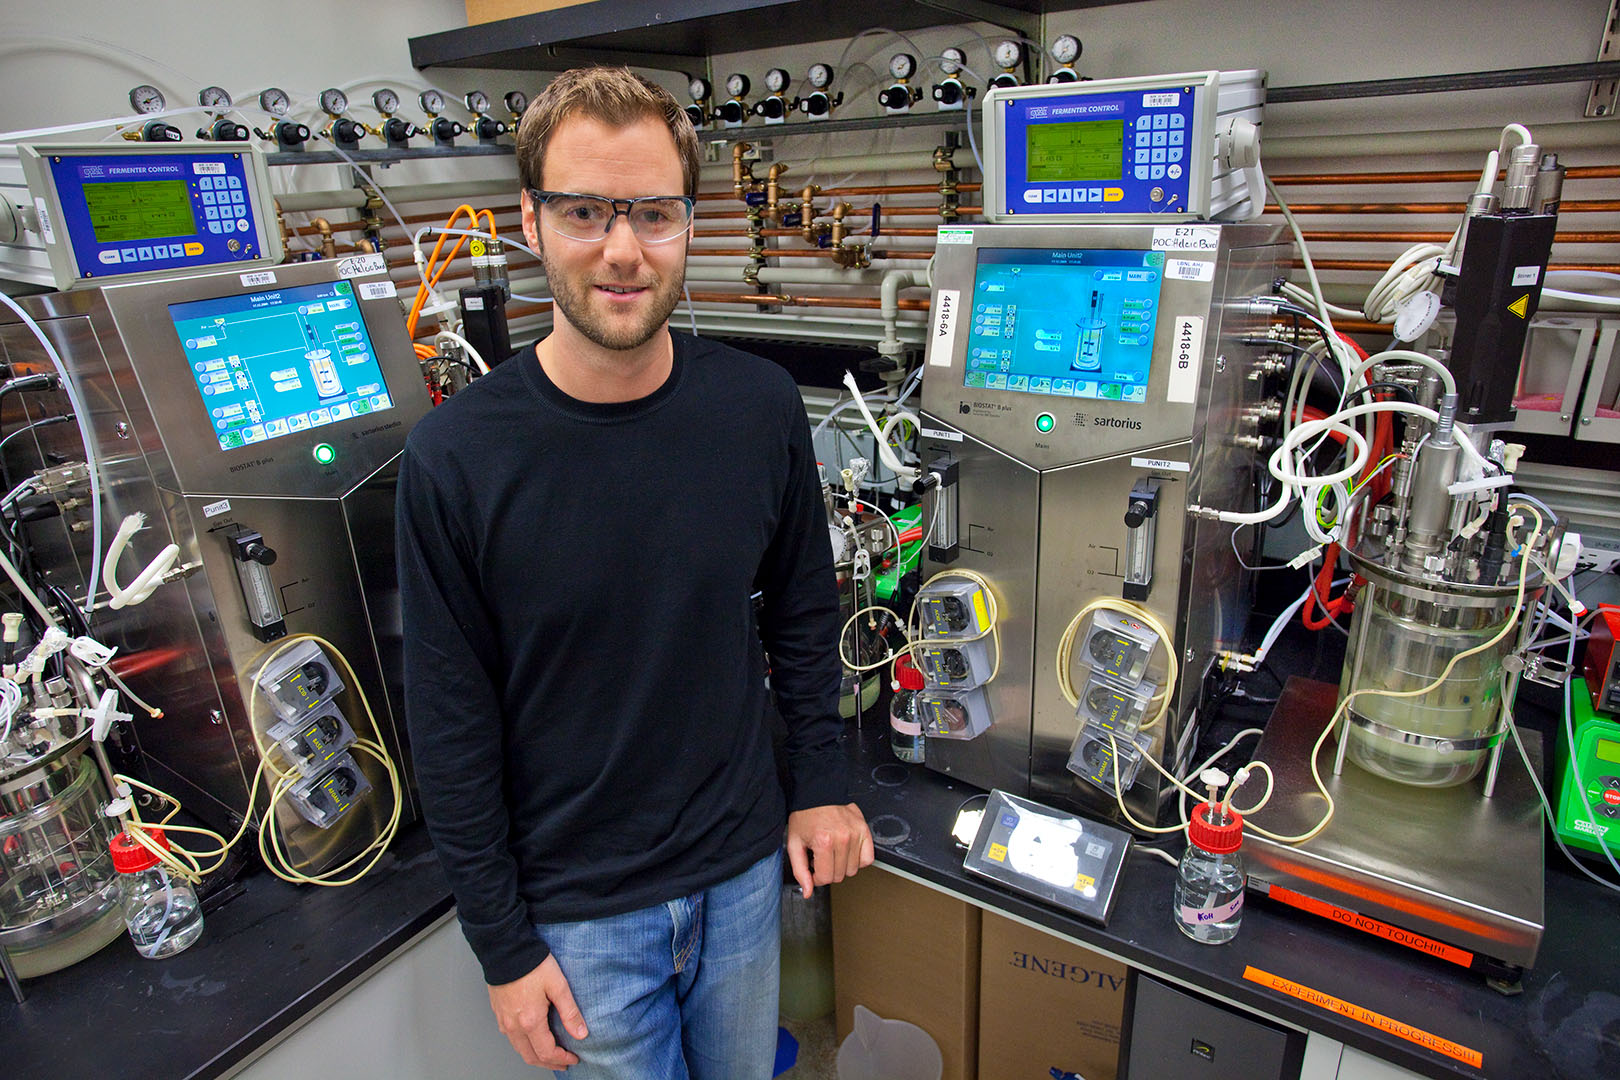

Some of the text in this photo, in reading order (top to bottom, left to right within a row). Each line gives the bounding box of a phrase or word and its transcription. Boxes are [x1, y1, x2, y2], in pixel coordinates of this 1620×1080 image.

[1052, 106, 1087, 115] FERMENTER
[1088, 104, 1120, 112] CONTROL
[1176, 228, 1194, 236] E-21
[939, 295, 951, 337] 4418-6A
[1178, 321, 1193, 369] 4418-6B
[1094, 416, 1142, 430] sartorius
[204, 502, 229, 514] Punit3
[1115, 654, 1124, 668] ACID
[296, 685, 307, 697] ACID
[1110, 709, 1118, 722] BASE
[312, 738, 323, 750] BASE
[1332, 909, 1446, 955] DO NOT TOUCH!!!
[1272, 978, 1476, 1062] EXPERIMENT IN PROGRESS!!!
